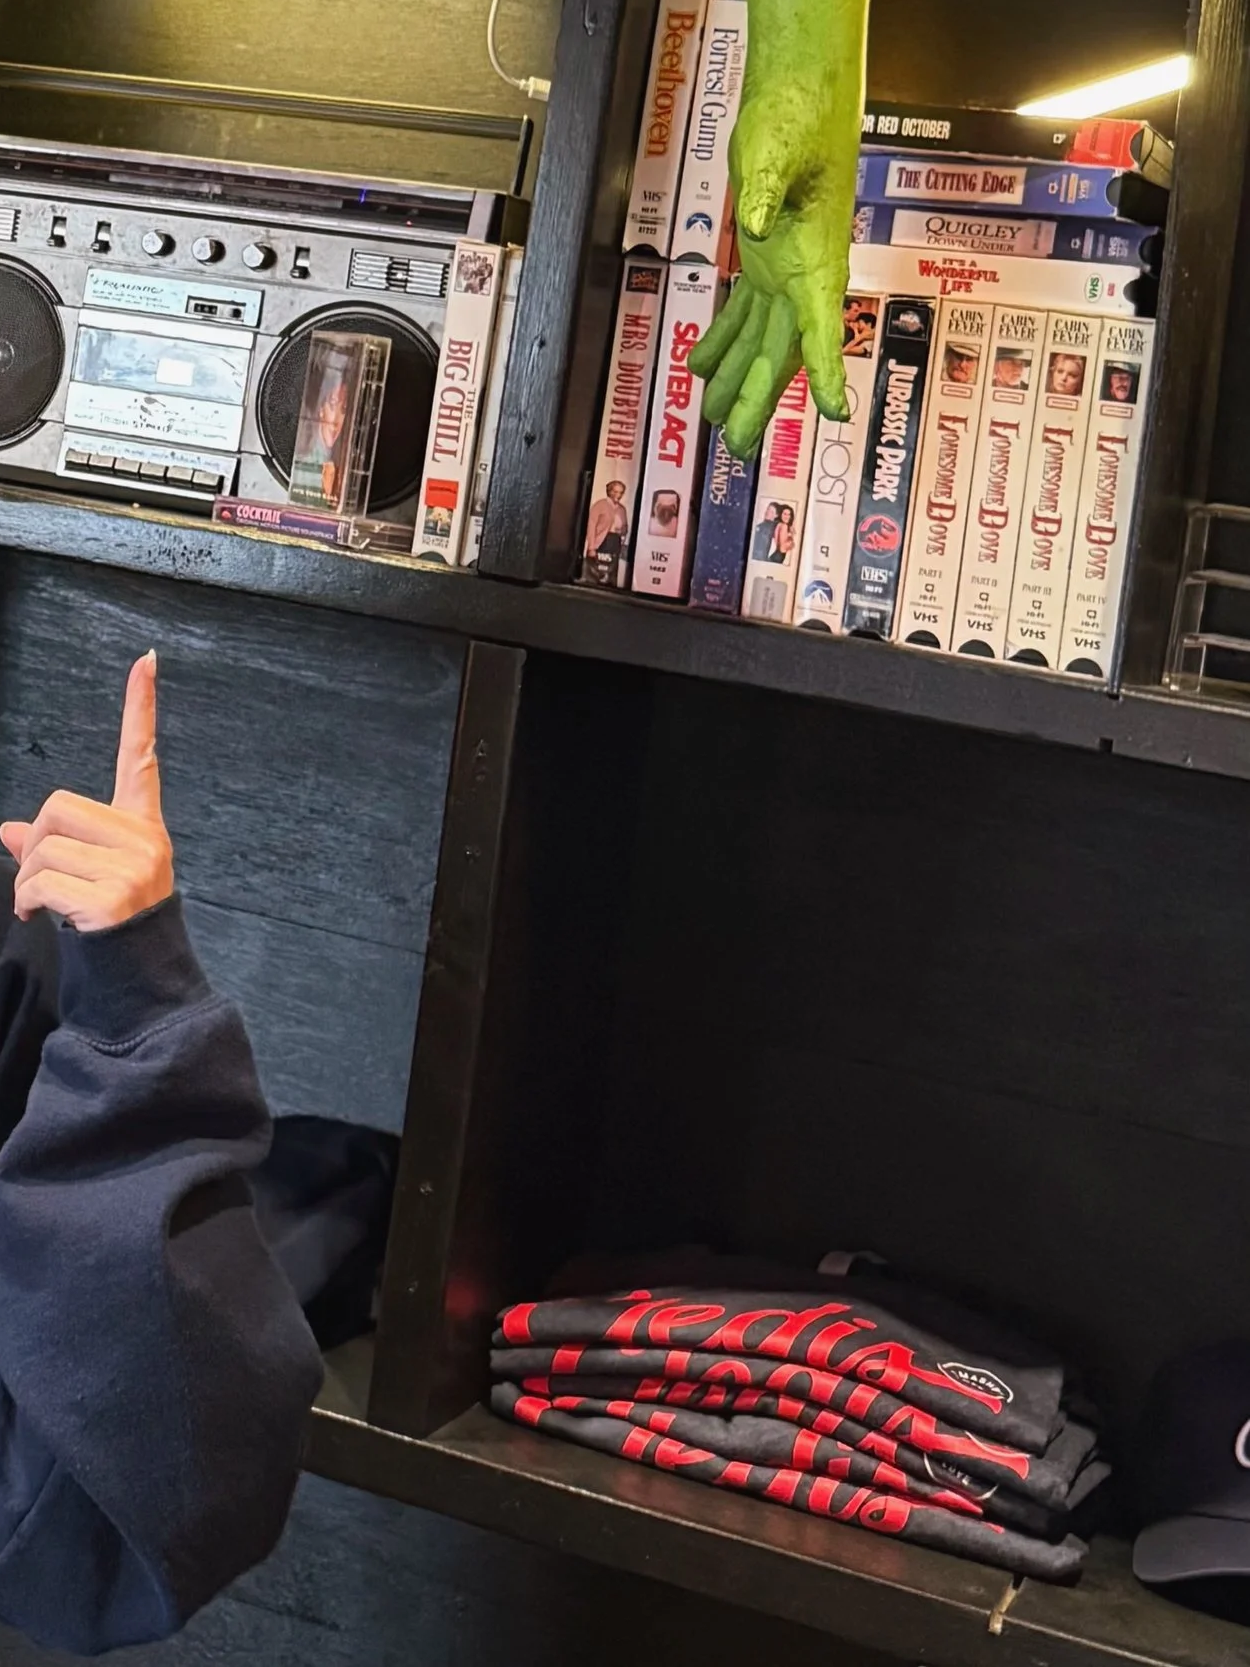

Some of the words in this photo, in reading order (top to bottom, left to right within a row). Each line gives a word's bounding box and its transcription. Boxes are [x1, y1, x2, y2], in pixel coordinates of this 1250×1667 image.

[703, 28, 739, 100] Forrest
[731, 44, 745, 68] Tom
[644, 9, 698, 159] Beethoven
[727, 66, 742, 98] Hanks
[690, 101, 728, 161] Gump
[861, 114, 875, 133] OR
[877, 115, 899, 134] RED
[902, 117, 951, 140] OCTOBER
[896, 166, 921, 189] THE
[925, 168, 978, 192] CUTTING
[981, 171, 1017, 195] EDGE
[925, 216, 1022, 240] QUIGLEY
[927, 235, 967, 248] DOWN
[971, 237, 1015, 252] UNDER
[918, 259, 1000, 283] WONDERFUL
[942, 257, 966, 267] IT'S
[969, 259, 977, 268] A
[940, 278, 973, 296] LIFE
[1089, 277, 1100, 299] VHS
[948, 319, 986, 334] FEVER
[950, 308, 985, 322] CABIN
[1001, 313, 1036, 328] CABIN
[1055, 318, 1090, 333] CABIN
[620, 313, 652, 354] MRS.
[999, 324, 1038, 339] FEVER
[1053, 330, 1092, 345] FEVER
[1109, 326, 1144, 340] CABIN
[1107, 337, 1146, 352] FEVER
[444, 338, 474, 382] BIG
[664, 320, 700, 410] SISTER
[464, 389, 476, 421] THE
[605, 361, 645, 461] DOUBTFIRE
[881, 359, 918, 446] JURASSIC
[432, 386, 466, 463] CHILL
[658, 410, 688, 469] ACT
[768, 418, 803, 480] WOMAN
[932, 411, 969, 499] LONESOME
[985, 416, 1021, 506] LONESOME
[872, 445, 907, 503] PARK
[1038, 423, 1074, 513] LONESOME
[1092, 431, 1130, 522] LONESOME
[236, 505, 281, 524] COCKTAIL
[924, 492, 957, 556] DOVE
[260, 521, 280, 530] MOTION
[281, 524, 300, 534] PICTURE
[300, 527, 334, 540] SOUNDTRACK
[977, 498, 1009, 564] DOVE
[1031, 505, 1063, 571] DOVE
[1085, 513, 1118, 580] DOVE
[861, 566, 888, 584] VHS
[918, 567, 937, 579] PART
[971, 575, 990, 586] PART
[1022, 583, 1042, 595] PART
[1076, 592, 1096, 604] PART
[913, 611, 938, 624] VHS
[967, 619, 993, 632] VHS
[1020, 627, 1046, 640] VHS
[1074, 637, 1101, 650] VHS
